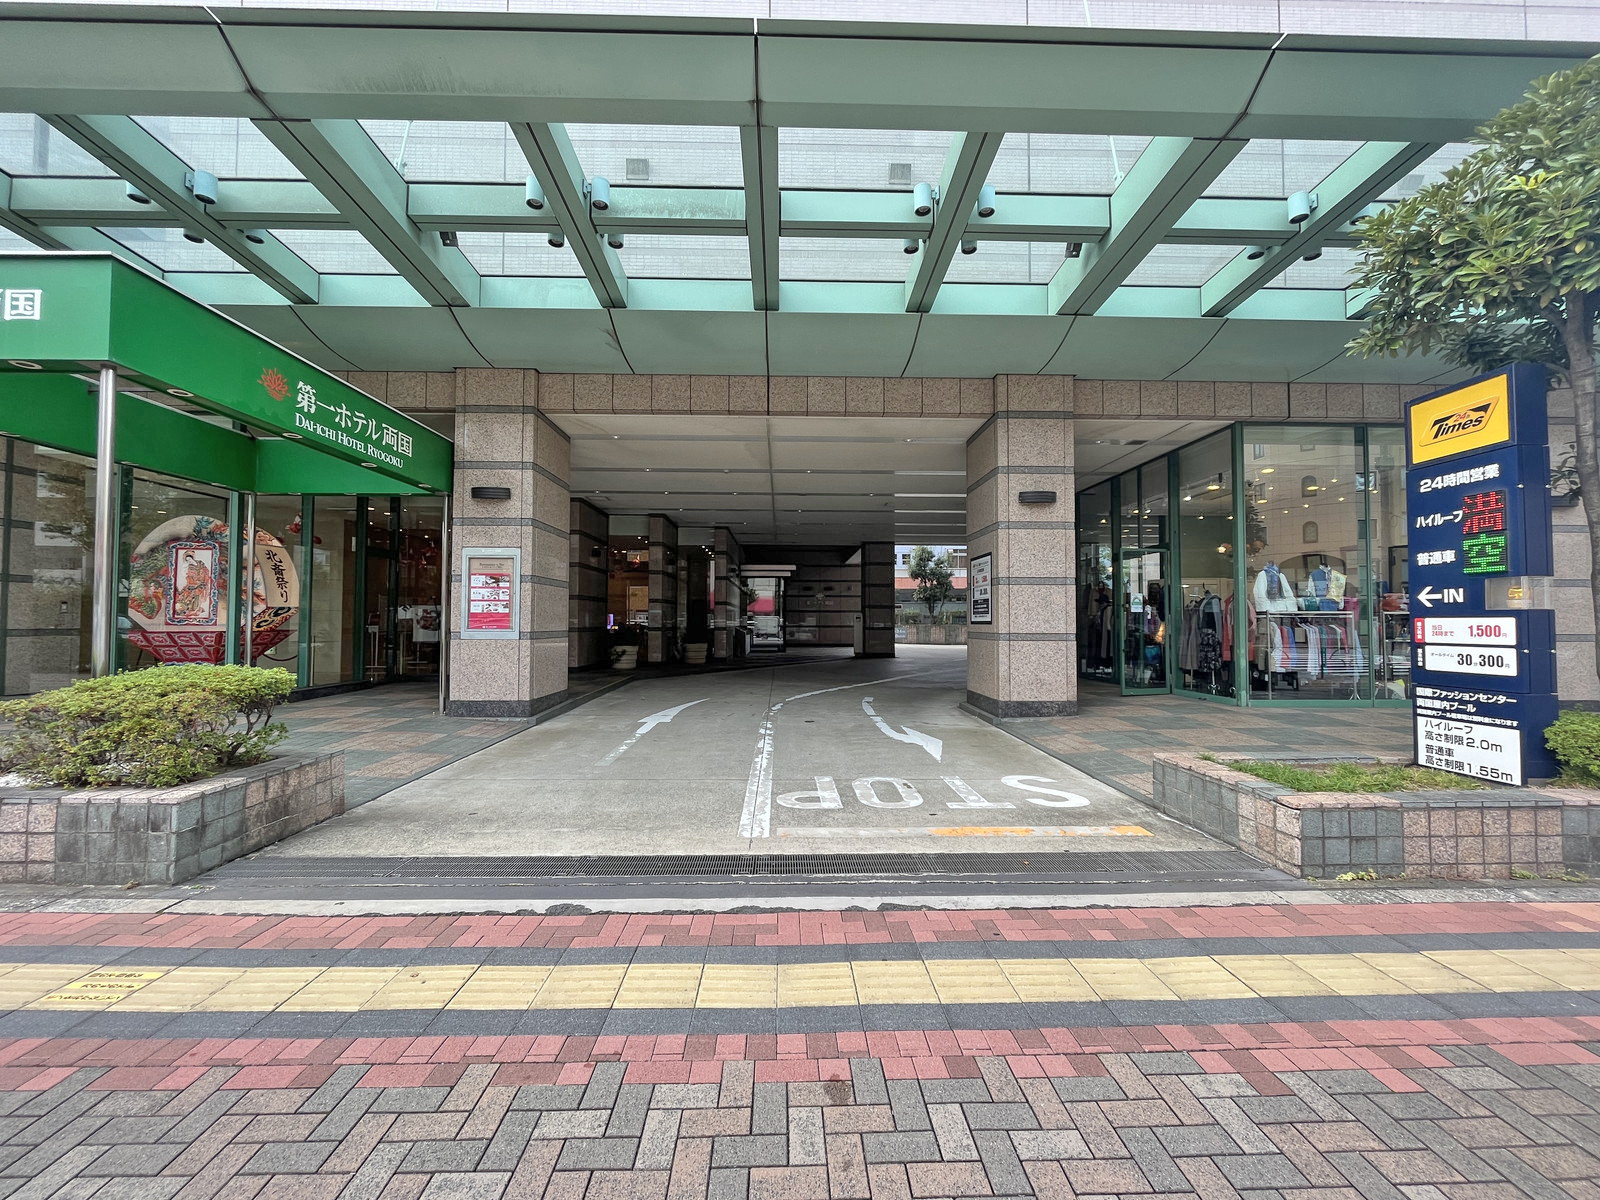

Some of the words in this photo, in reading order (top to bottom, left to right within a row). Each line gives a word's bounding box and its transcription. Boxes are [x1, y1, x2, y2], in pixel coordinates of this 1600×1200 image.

[295, 380, 413, 458] 第一ホテル両国
[1430, 406, 1489, 440] Times
[337, 430, 367, 454] HOTEL
[367, 444, 404, 469] RYOGOKU
[1419, 463, 1500, 493] 24時間営業
[1415, 509, 1464, 529] ハイルーフ
[1462, 491, 1505, 534] 満
[1416, 549, 1456, 567] 普通車
[1462, 533, 1506, 574] 空
[1443, 587, 1465, 604] IN
[1424, 719, 1474, 735] ハイルーフ
[1424, 730, 1503, 753] 高さ制限2.0m
[1425, 743, 1455, 758] 普通車
[1424, 754, 1513, 783] 高さ制限1.55m
[776, 775, 1092, 810] STOP
